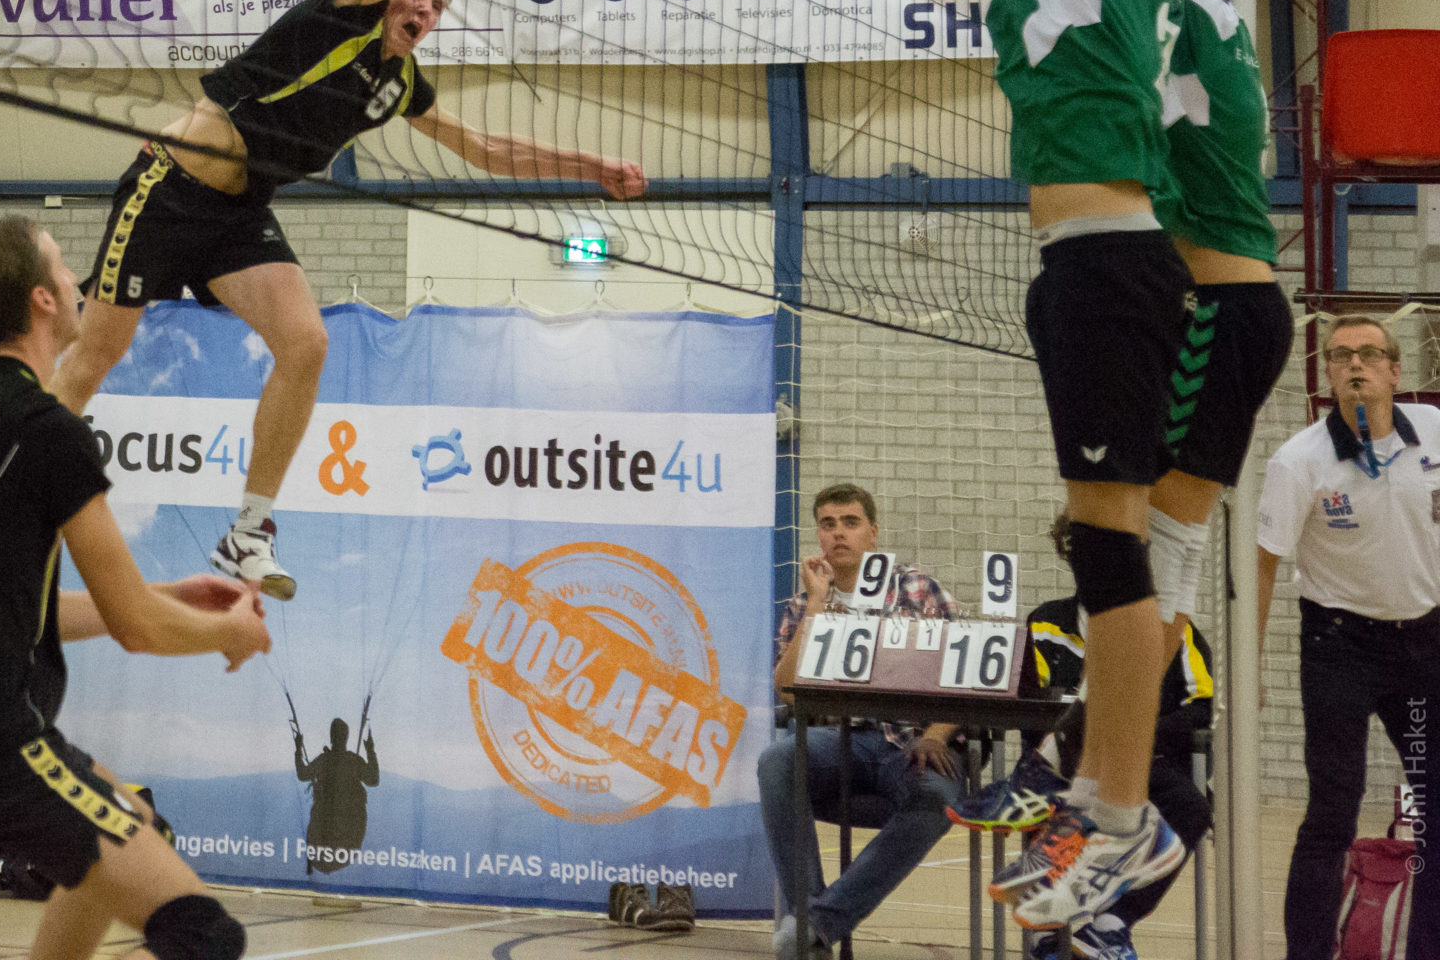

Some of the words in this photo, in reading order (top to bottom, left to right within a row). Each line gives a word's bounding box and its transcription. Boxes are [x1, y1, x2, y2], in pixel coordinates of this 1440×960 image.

[213, 0, 233, 13] als
[241, 0, 255, 16] je
[514, 12, 577, 24] Computers
[597, 10, 636, 22] Tablets
[661, 9, 716, 23] Reparatie
[736, 7, 793, 19] Televisies
[811, 4, 873, 17] Domotica
[904, 3, 982, 49] SH
[127, 275, 143, 299] 5
[318, 420, 370, 496] &
[485, 433, 723, 493] outsite4u
[860, 553, 889, 597] 9
[987, 553, 1013, 603] 9
[889, 626, 902, 645] 0
[925, 628, 934, 646] 1
[513, 728, 611, 794] DEDICATED
[477, 853, 542, 877] AFAS
[550, 860, 738, 889] applicatiebeheer
